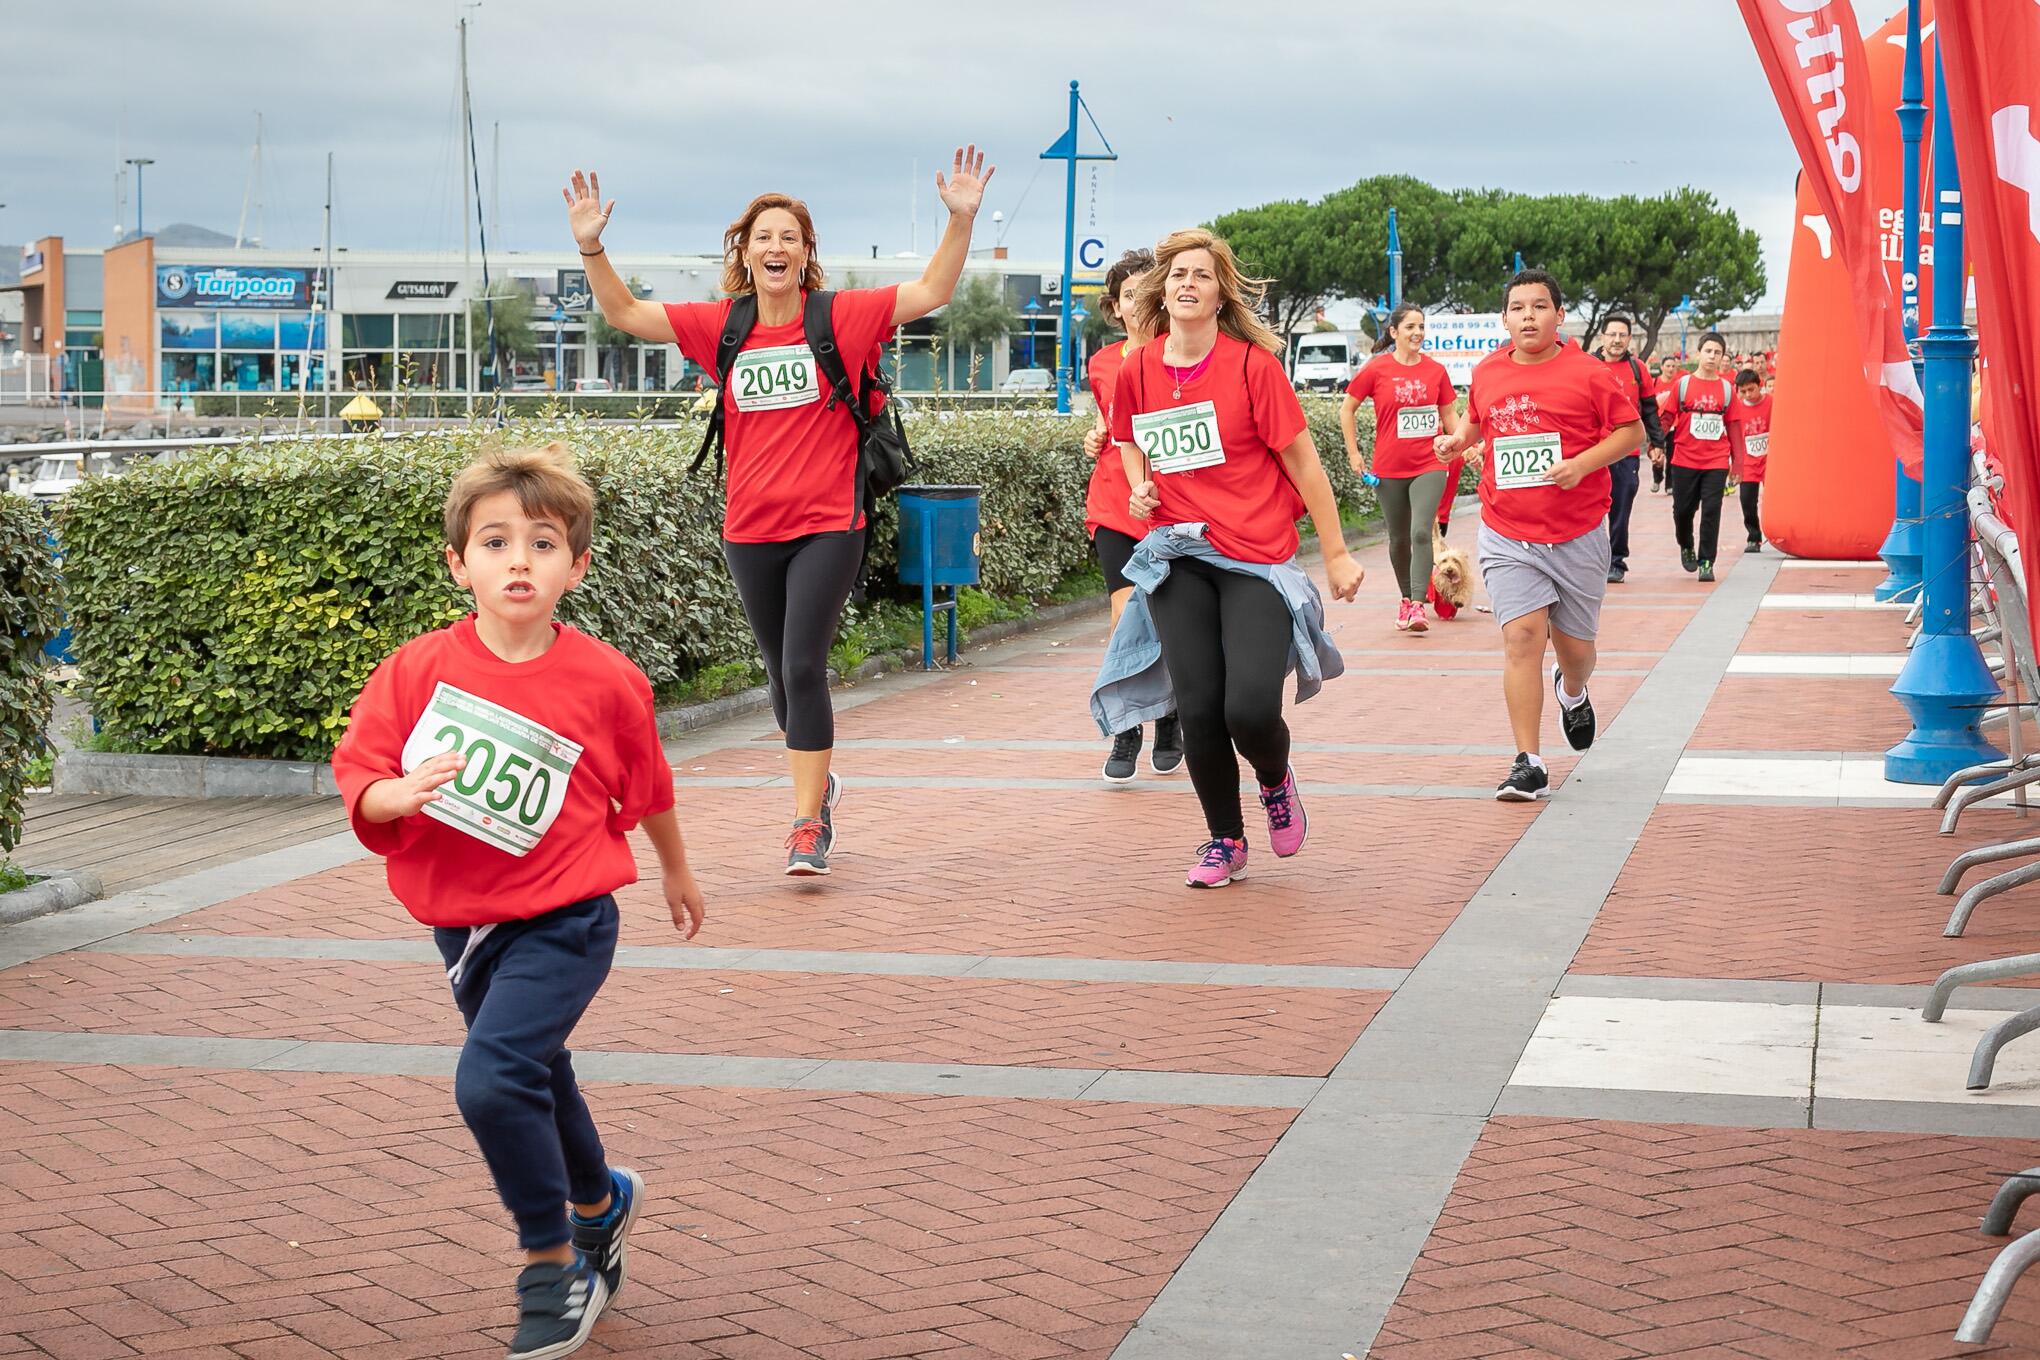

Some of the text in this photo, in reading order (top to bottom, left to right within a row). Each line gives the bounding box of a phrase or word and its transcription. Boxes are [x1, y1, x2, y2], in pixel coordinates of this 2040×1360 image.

[1089, 166, 1098, 227] PANTALAN
[1079, 238, 1105, 269] C
[194, 272, 296, 300] Tarpoon
[740, 361, 808, 396] 2049
[1402, 414, 1436, 430] 2049
[1144, 421, 1211, 459] 2050
[1500, 448, 1555, 476] 2023
[419, 725, 551, 826] 2050
